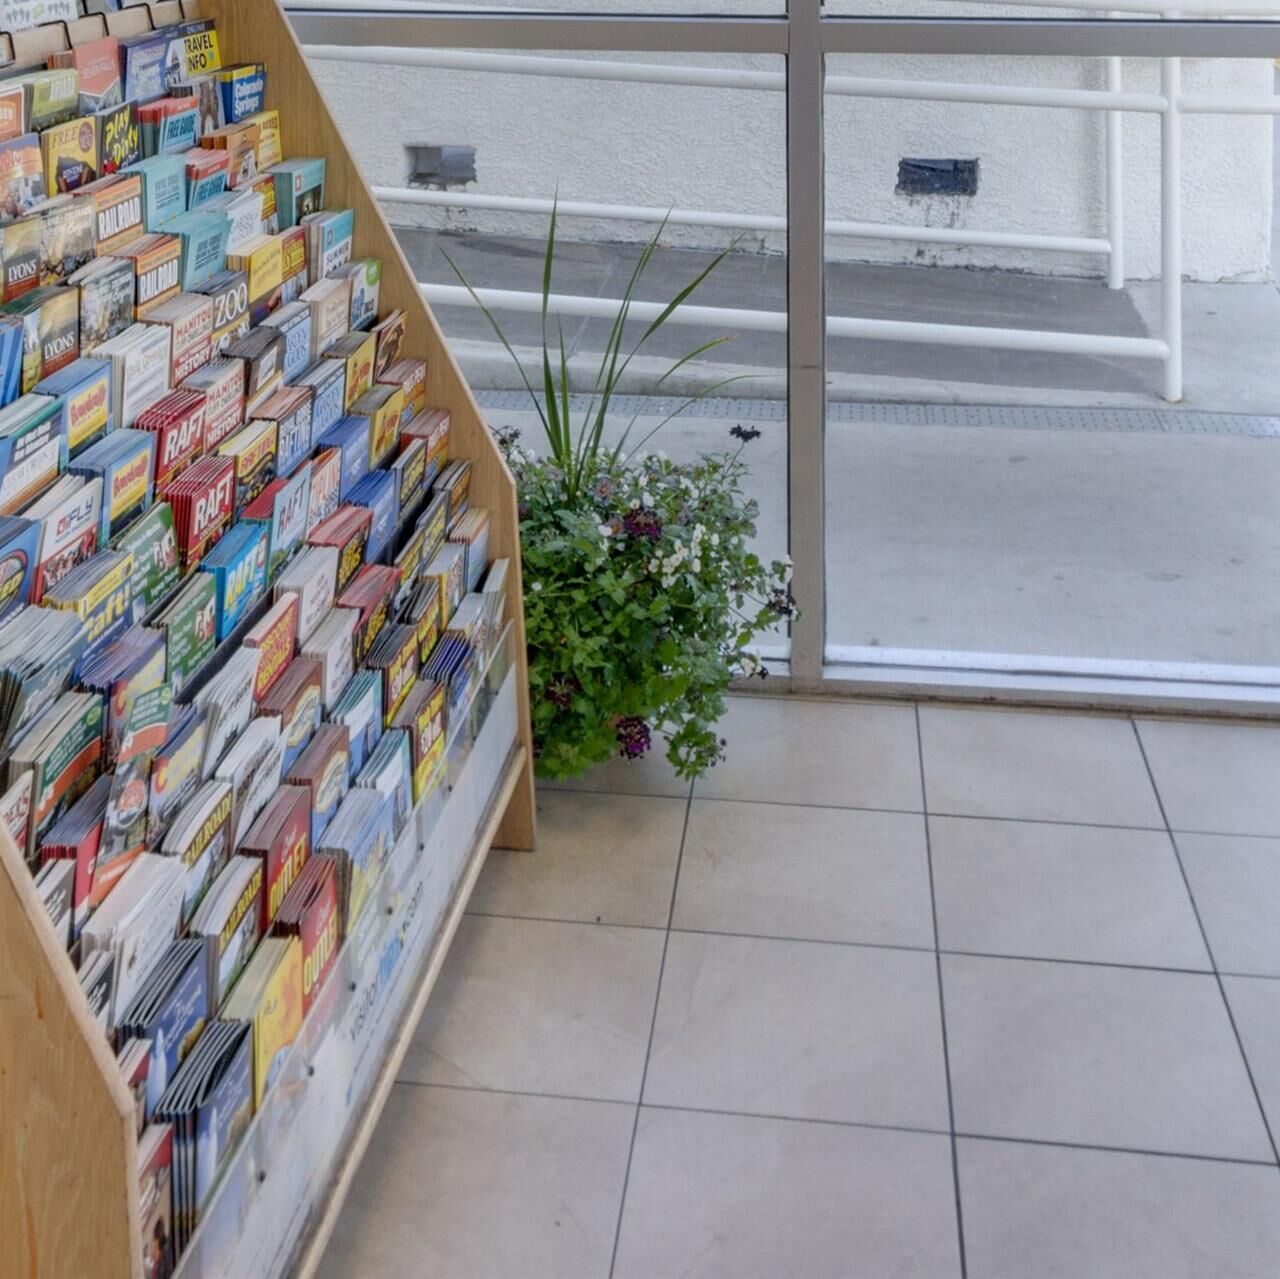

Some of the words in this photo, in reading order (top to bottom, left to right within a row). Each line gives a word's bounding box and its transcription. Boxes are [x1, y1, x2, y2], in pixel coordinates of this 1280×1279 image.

[184, 33, 214, 54] TRAVEL
[187, 52, 207, 72] INFO
[98, 197, 141, 241] RAILROAD
[7, 258, 38, 283] LYONS
[139, 258, 179, 304] RAILROAD
[176, 307, 213, 338] MANITOU
[214, 281, 248, 330] ZOO
[43, 330, 75, 360] LYONS
[163, 407, 207, 465] RAFT
[194, 476, 233, 536] RAFT
